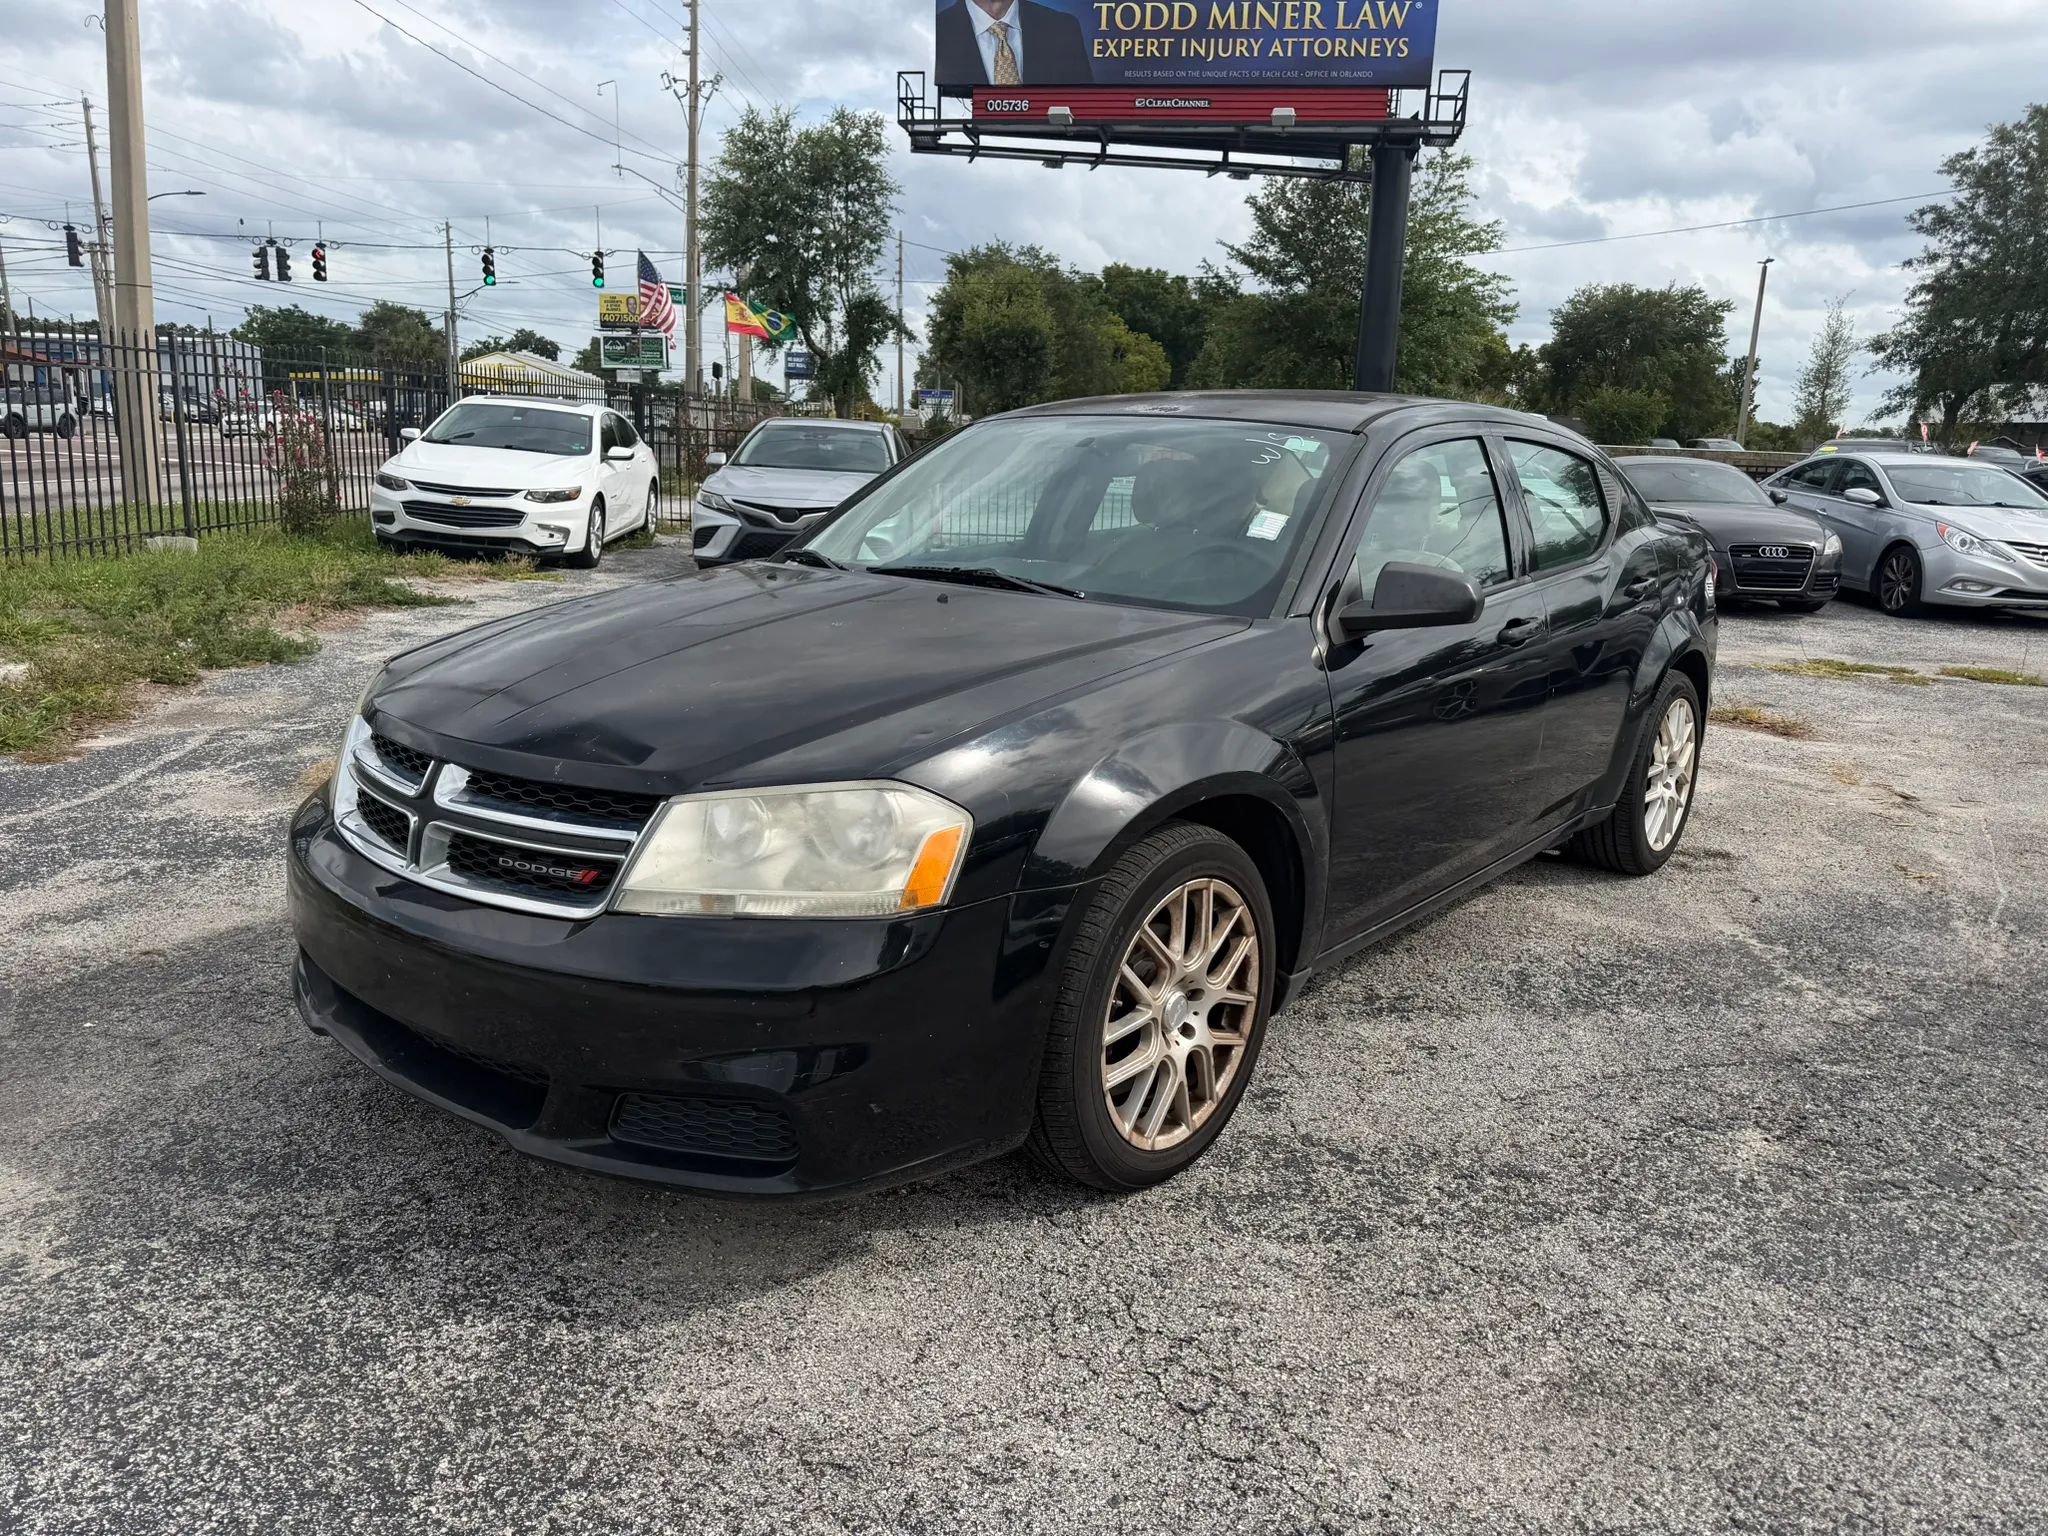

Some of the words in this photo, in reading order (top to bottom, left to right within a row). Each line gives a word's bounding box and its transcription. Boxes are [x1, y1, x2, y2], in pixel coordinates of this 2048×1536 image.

[1093, 2, 1198, 31] TODD
[1206, 1, 1327, 30] MINER
[1093, 38, 1175, 58] EXPERT
[1181, 38, 1264, 62] INJURY
[1268, 37, 1409, 58] ATTORNEYS
[1124, 70, 1152, 78] RESULTS
[1153, 70, 1175, 78] BASED
[1176, 70, 1186, 78] ON
[1188, 70, 1201, 78] THE
[1202, 70, 1227, 78] UNIQUE
[1229, 70, 1250, 78] FACTS
[1251, 70, 1260, 78] OF
[1262, 70, 1281, 78] EACH
[1281, 70, 1299, 78] CASE
[1304, 70, 1329, 78] OFFICE
[1330, 70, 1338, 78] IN
[1339, 70, 1374, 78] ORLANDO
[987, 99, 1029, 111] 005736
[499, 857, 584, 880] DODGE
